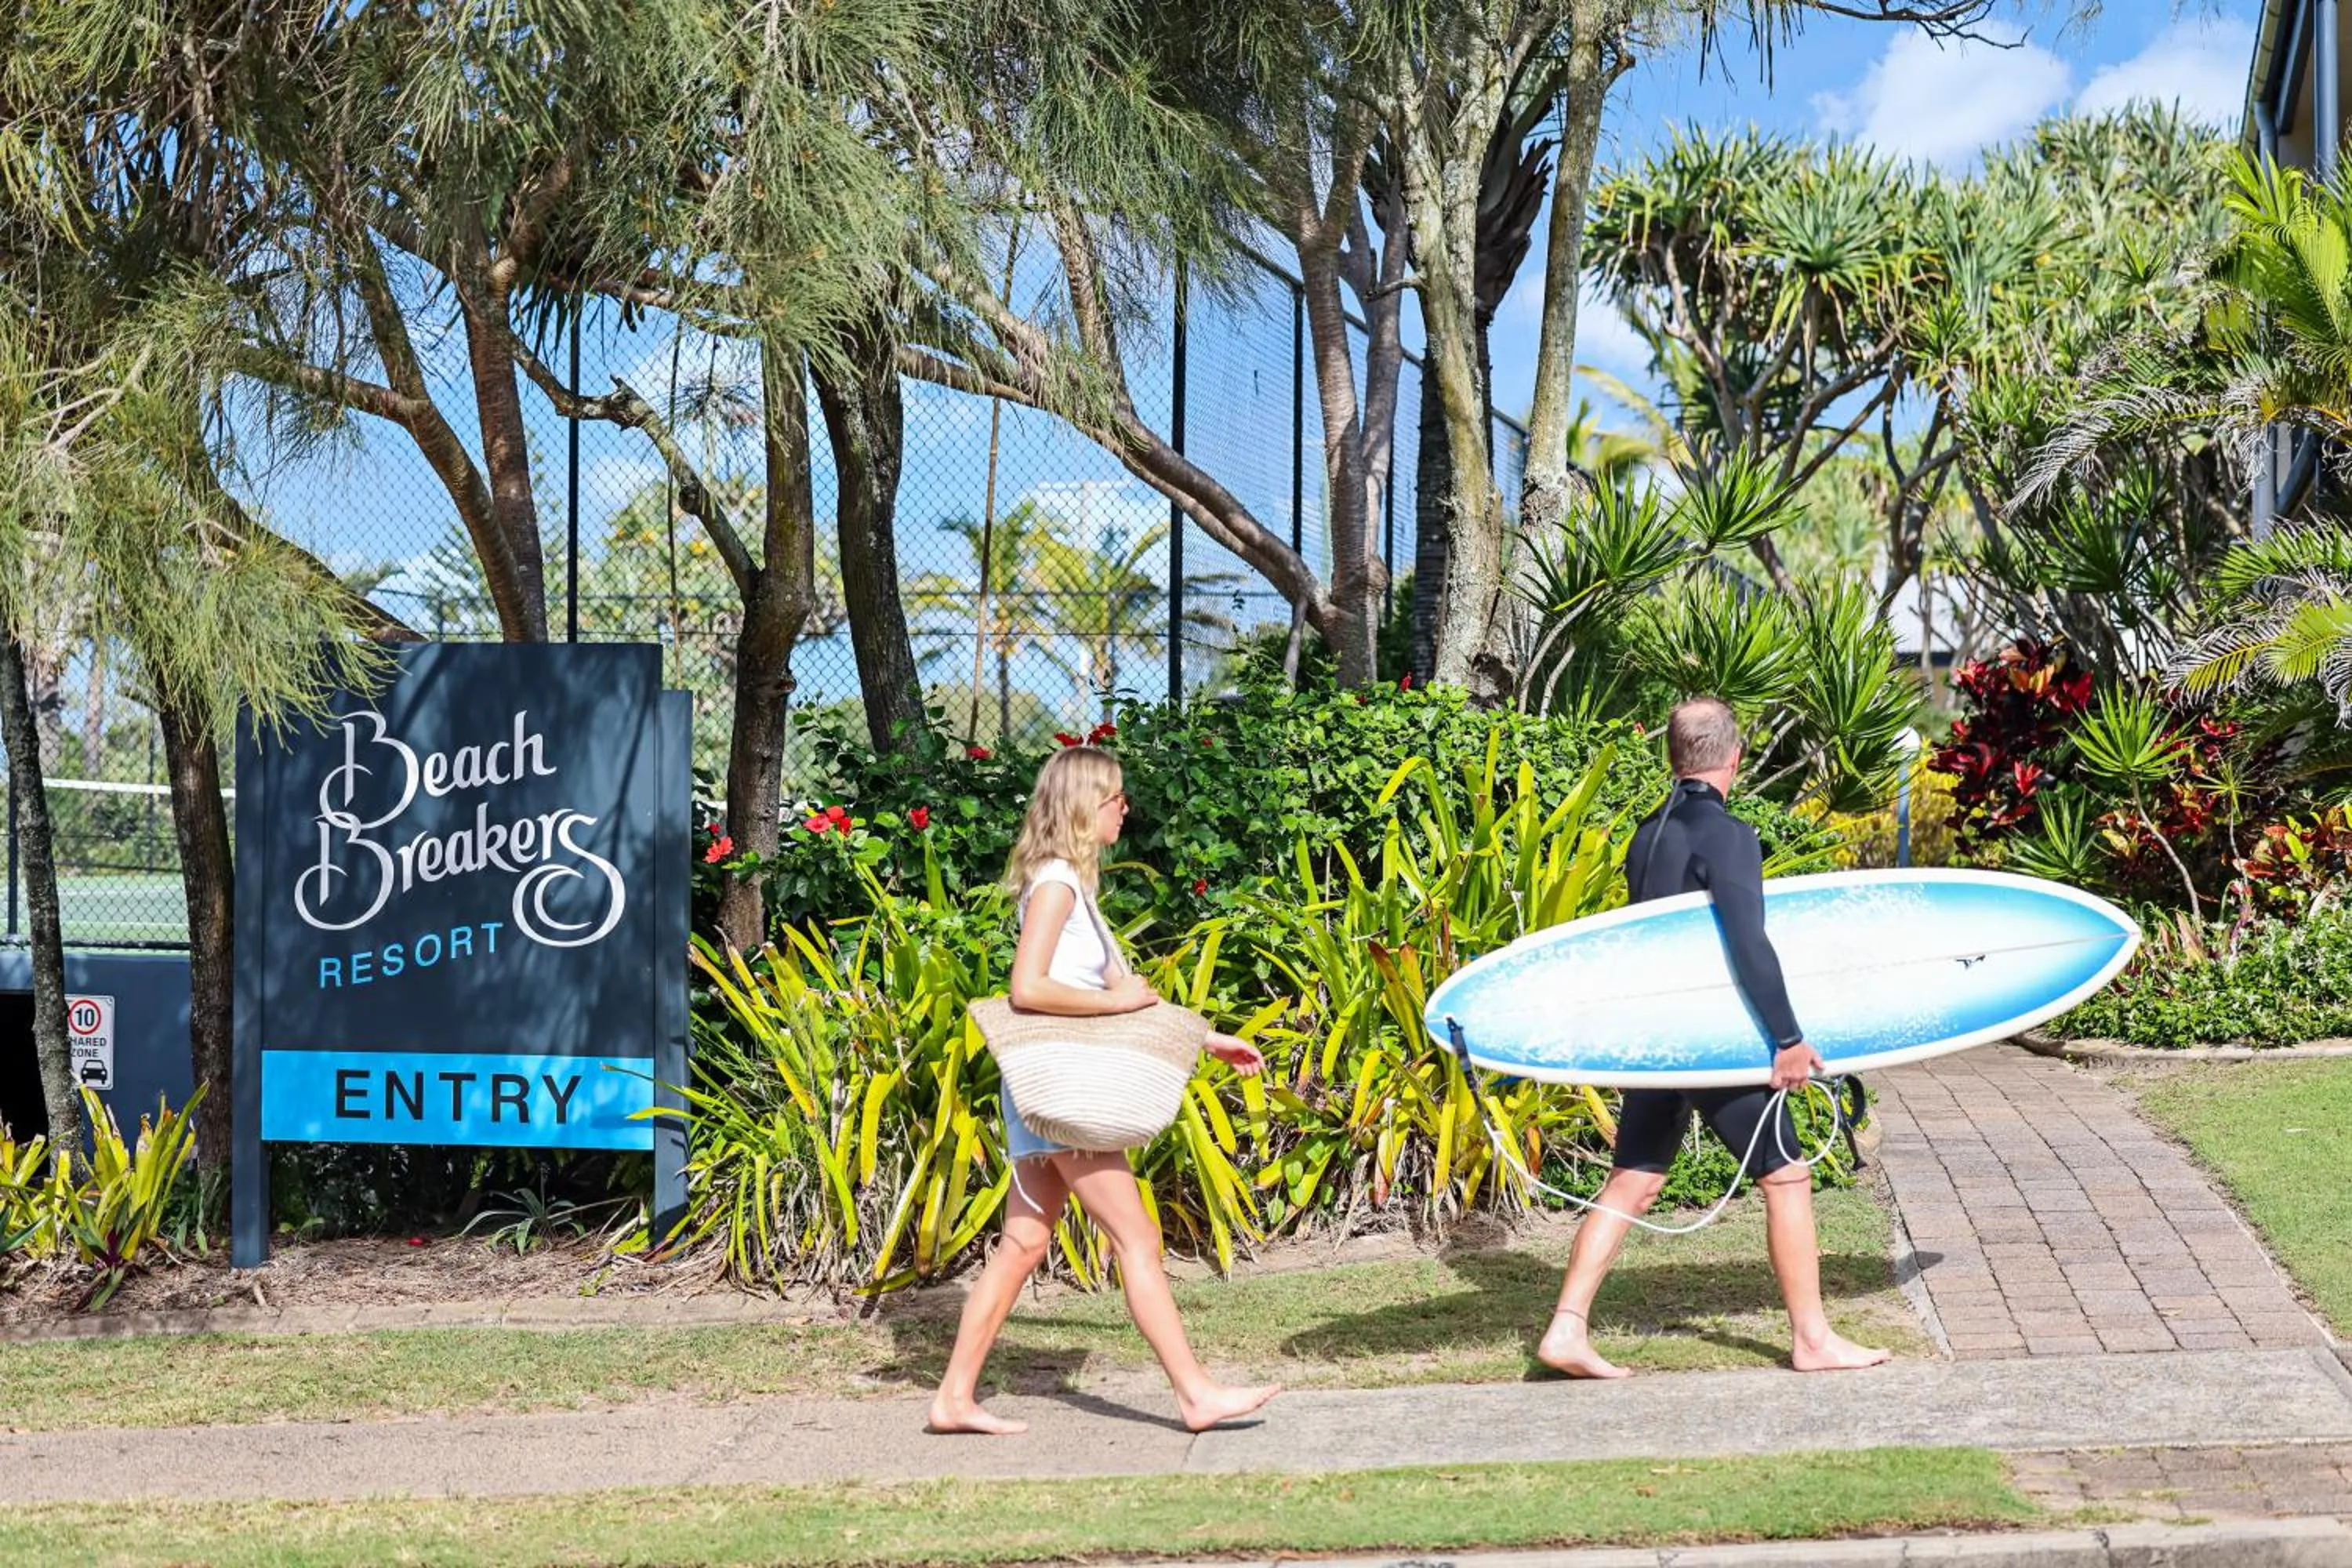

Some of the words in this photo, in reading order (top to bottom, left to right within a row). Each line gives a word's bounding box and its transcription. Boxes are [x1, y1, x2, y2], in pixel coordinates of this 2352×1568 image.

[318, 710, 557, 829] Beach
[293, 802, 626, 948] Breakers
[318, 921, 504, 989] RESORT
[69, 1036, 107, 1047] HARED
[74, 1008, 95, 1026] 10
[334, 1068, 582, 1125] ENTRY
